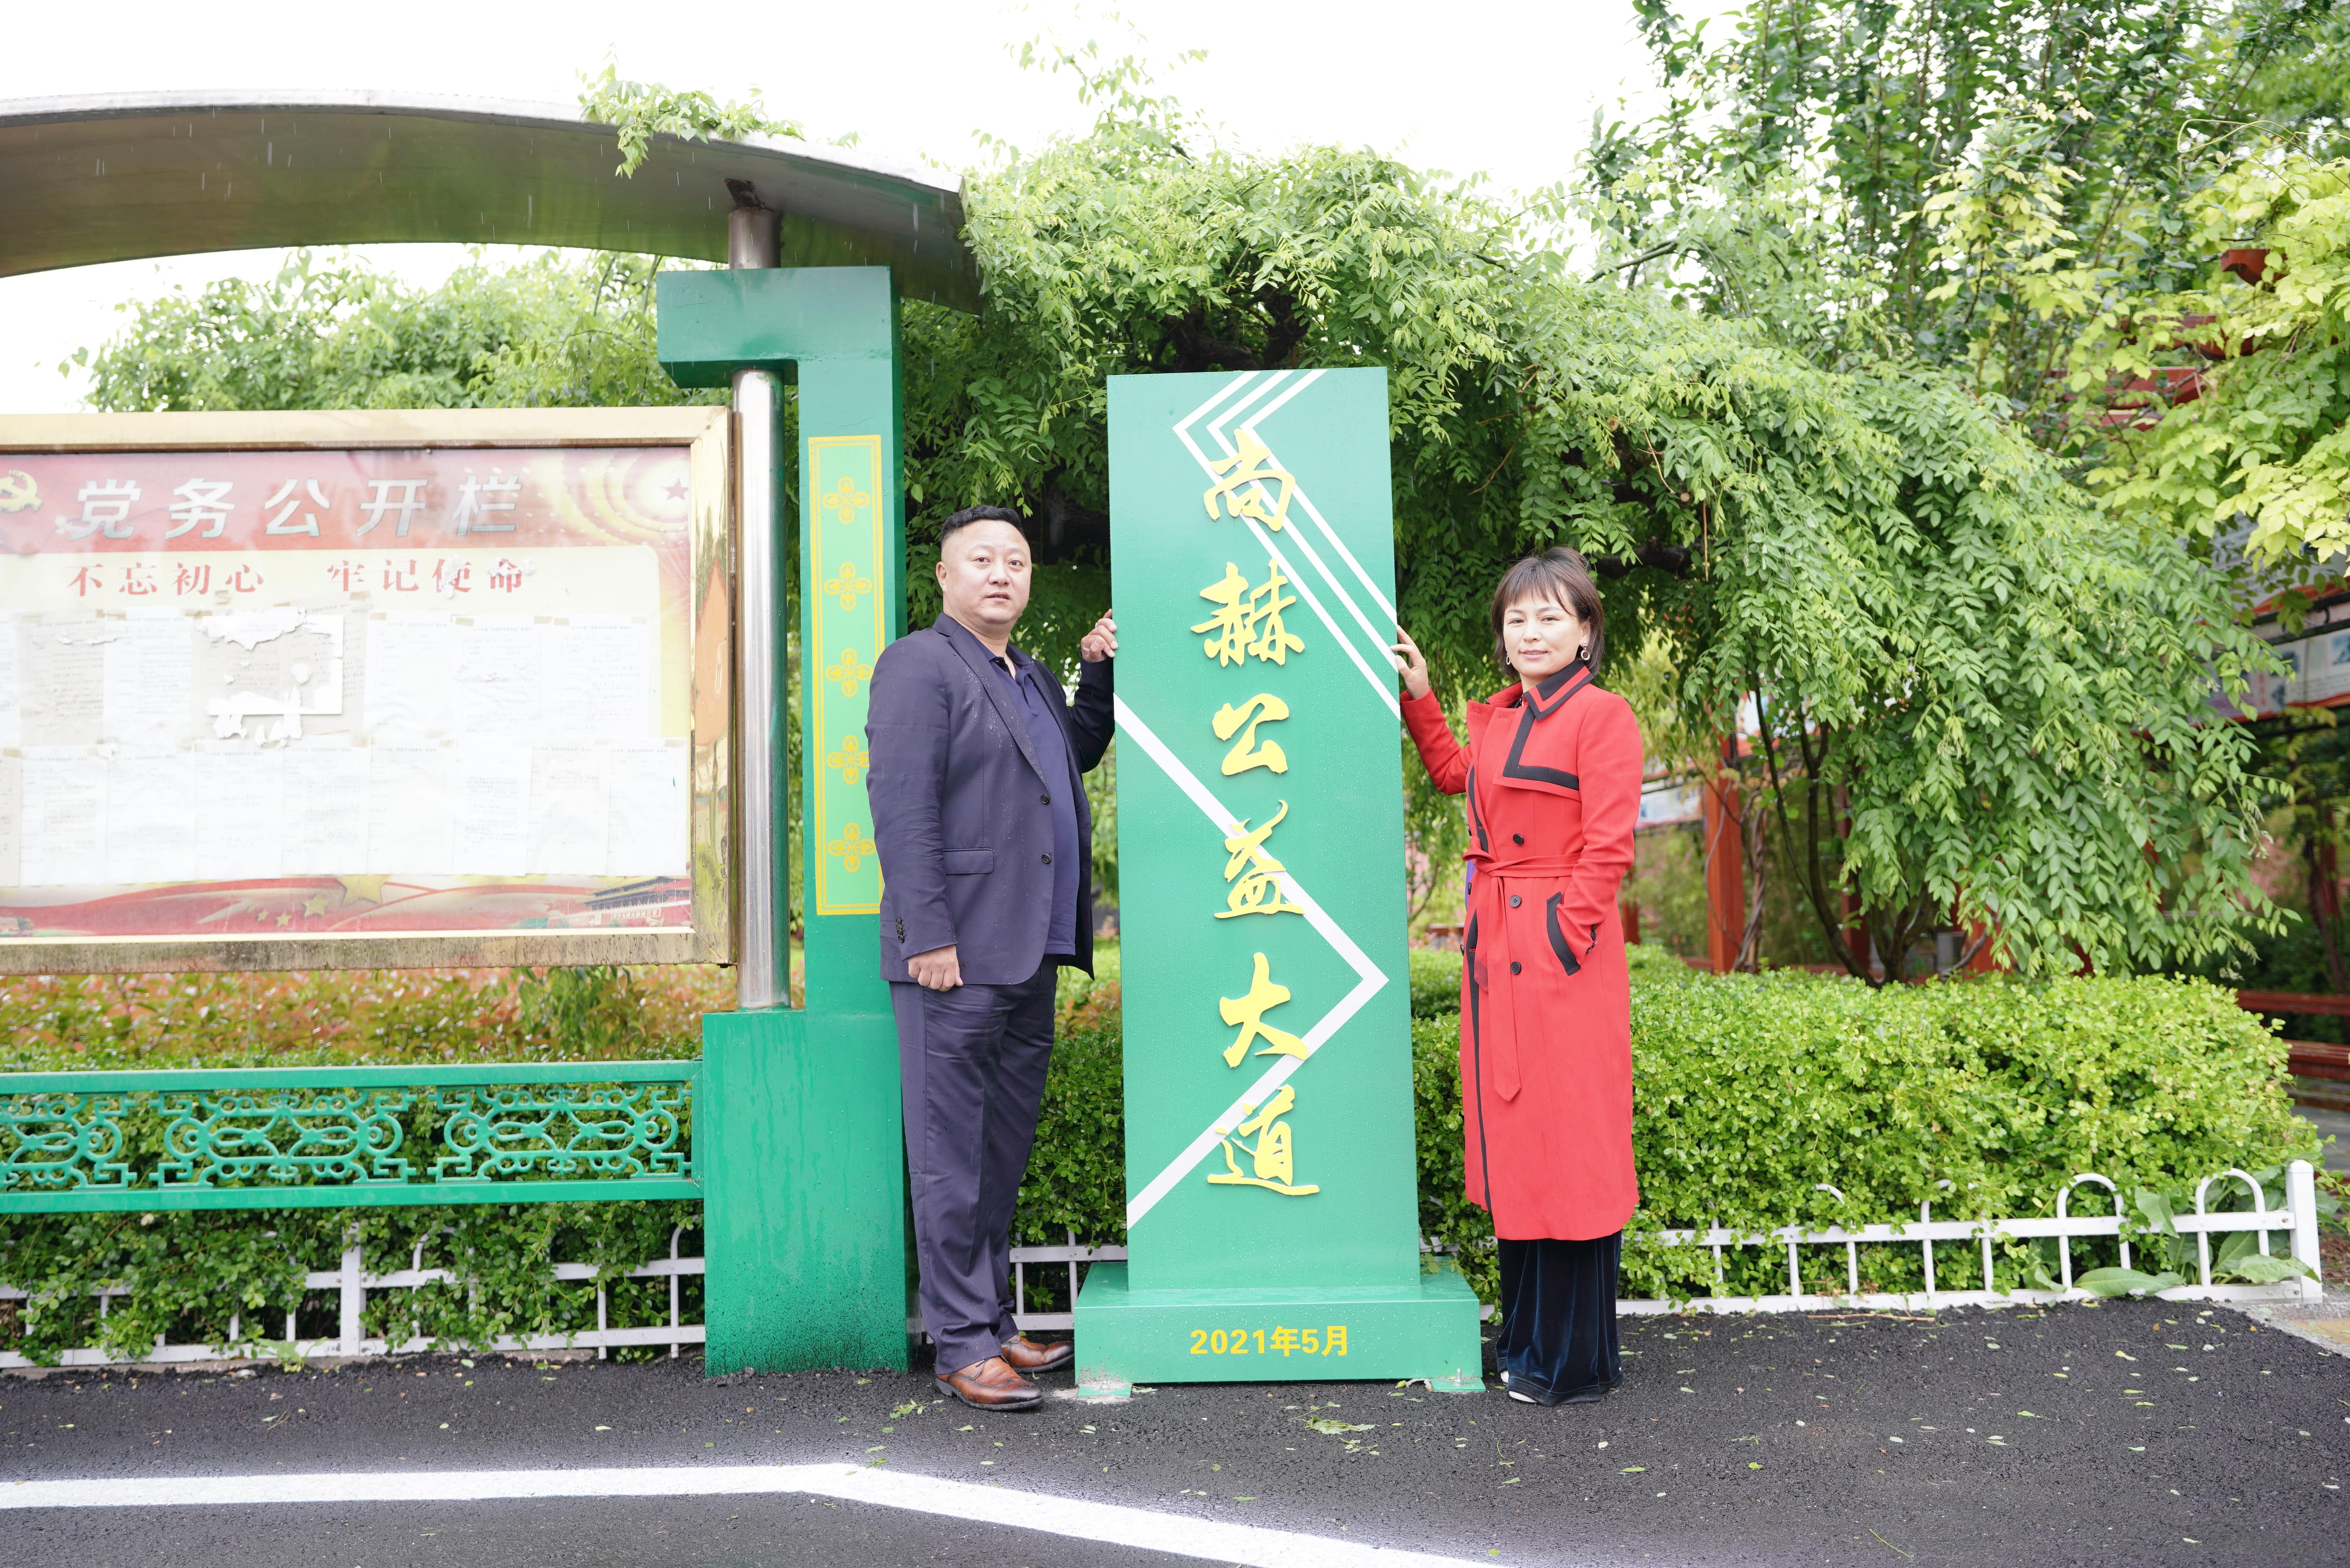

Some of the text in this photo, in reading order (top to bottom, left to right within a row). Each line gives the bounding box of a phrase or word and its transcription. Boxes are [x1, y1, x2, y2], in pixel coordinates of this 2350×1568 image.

[70, 475, 522, 540] 党务公开栏
[65, 563, 264, 597] 不忘初心
[1190, 428, 1320, 1196] 尚赫公益大道
[1190, 1326, 1349, 1357] 2021年5月
